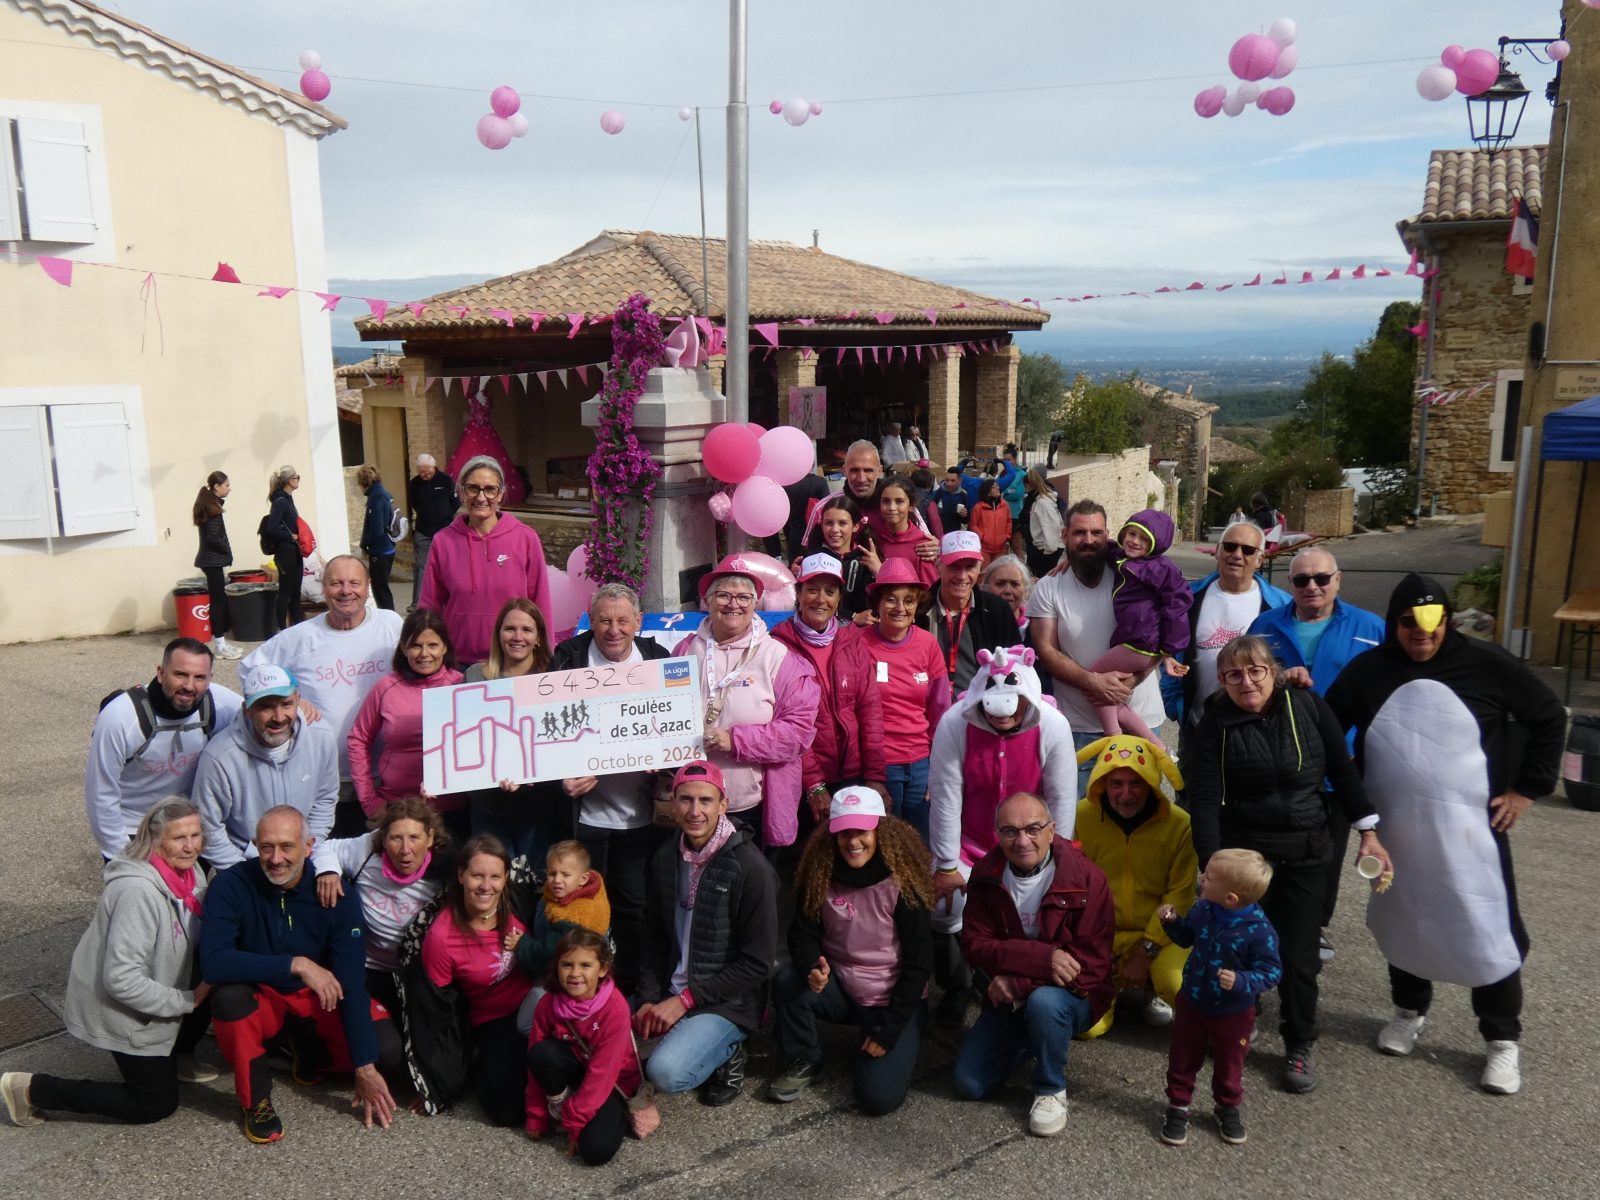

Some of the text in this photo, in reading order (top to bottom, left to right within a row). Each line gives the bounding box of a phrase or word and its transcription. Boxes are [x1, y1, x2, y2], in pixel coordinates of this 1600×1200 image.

[621, 699, 672, 717] Foulées
[610, 715, 692, 738] de Salazac
[587, 745, 702, 771] Octobre 2026
